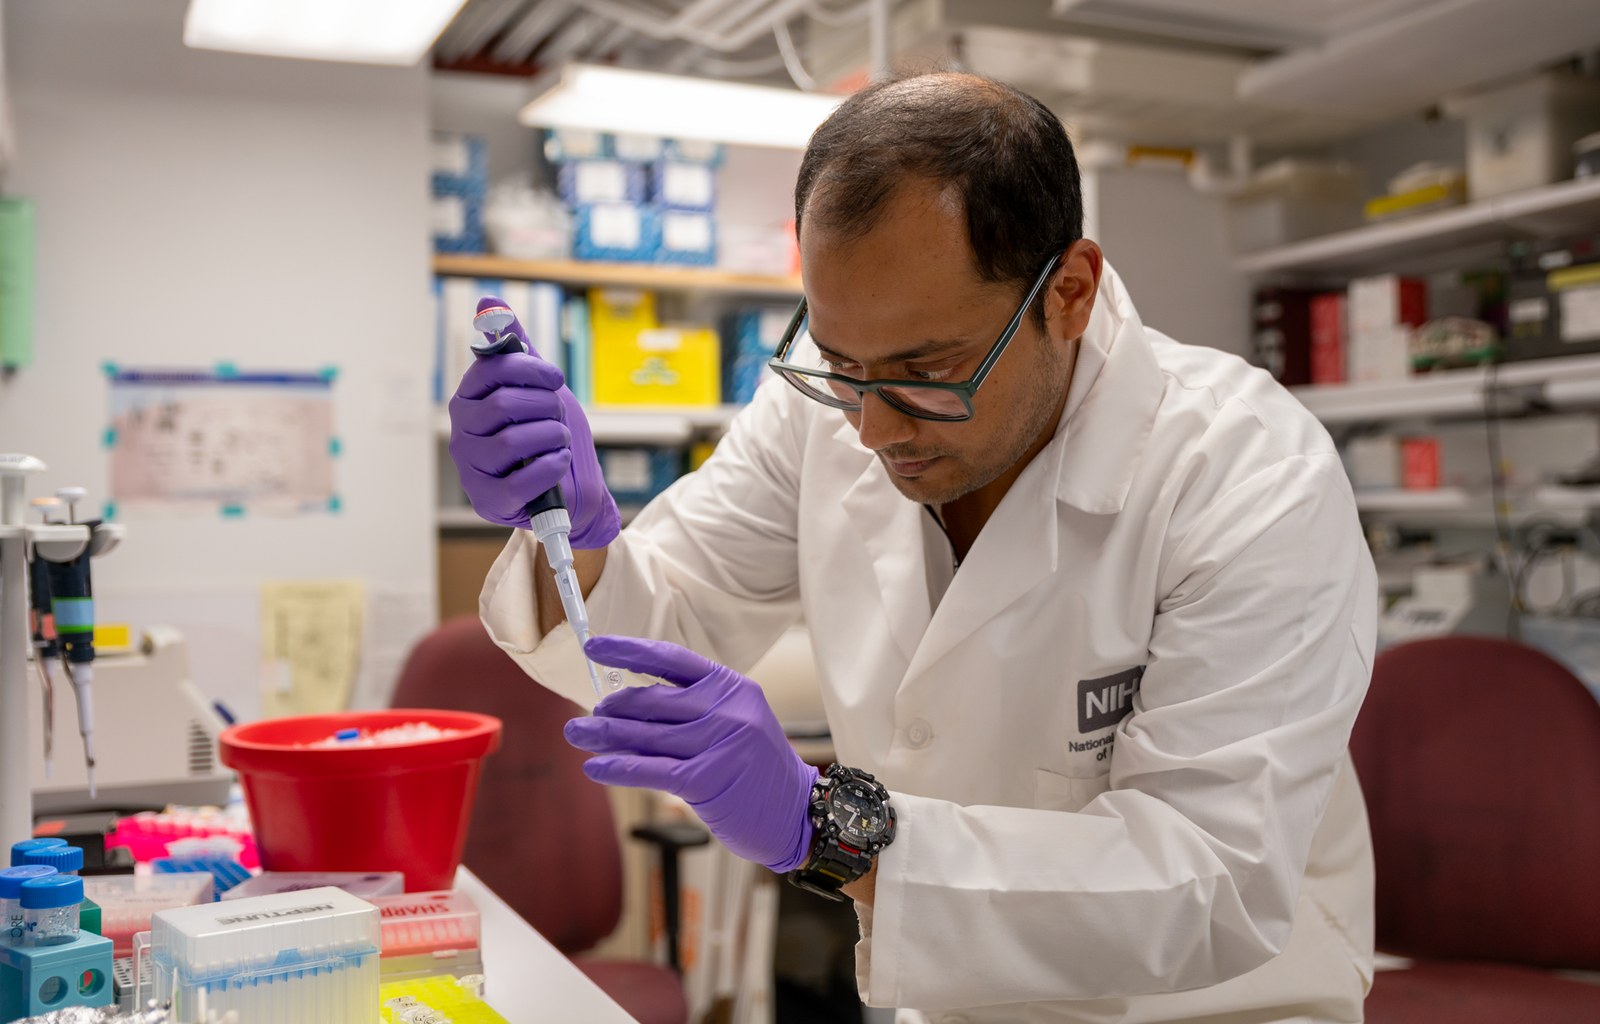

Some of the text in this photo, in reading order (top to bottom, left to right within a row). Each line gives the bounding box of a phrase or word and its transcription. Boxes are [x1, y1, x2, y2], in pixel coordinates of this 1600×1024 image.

[1086, 677, 1139, 719] NIH
[1068, 732, 1115, 752] National
[1096, 748, 1107, 761] of
[217, 903, 335, 926] NEPTUNE
